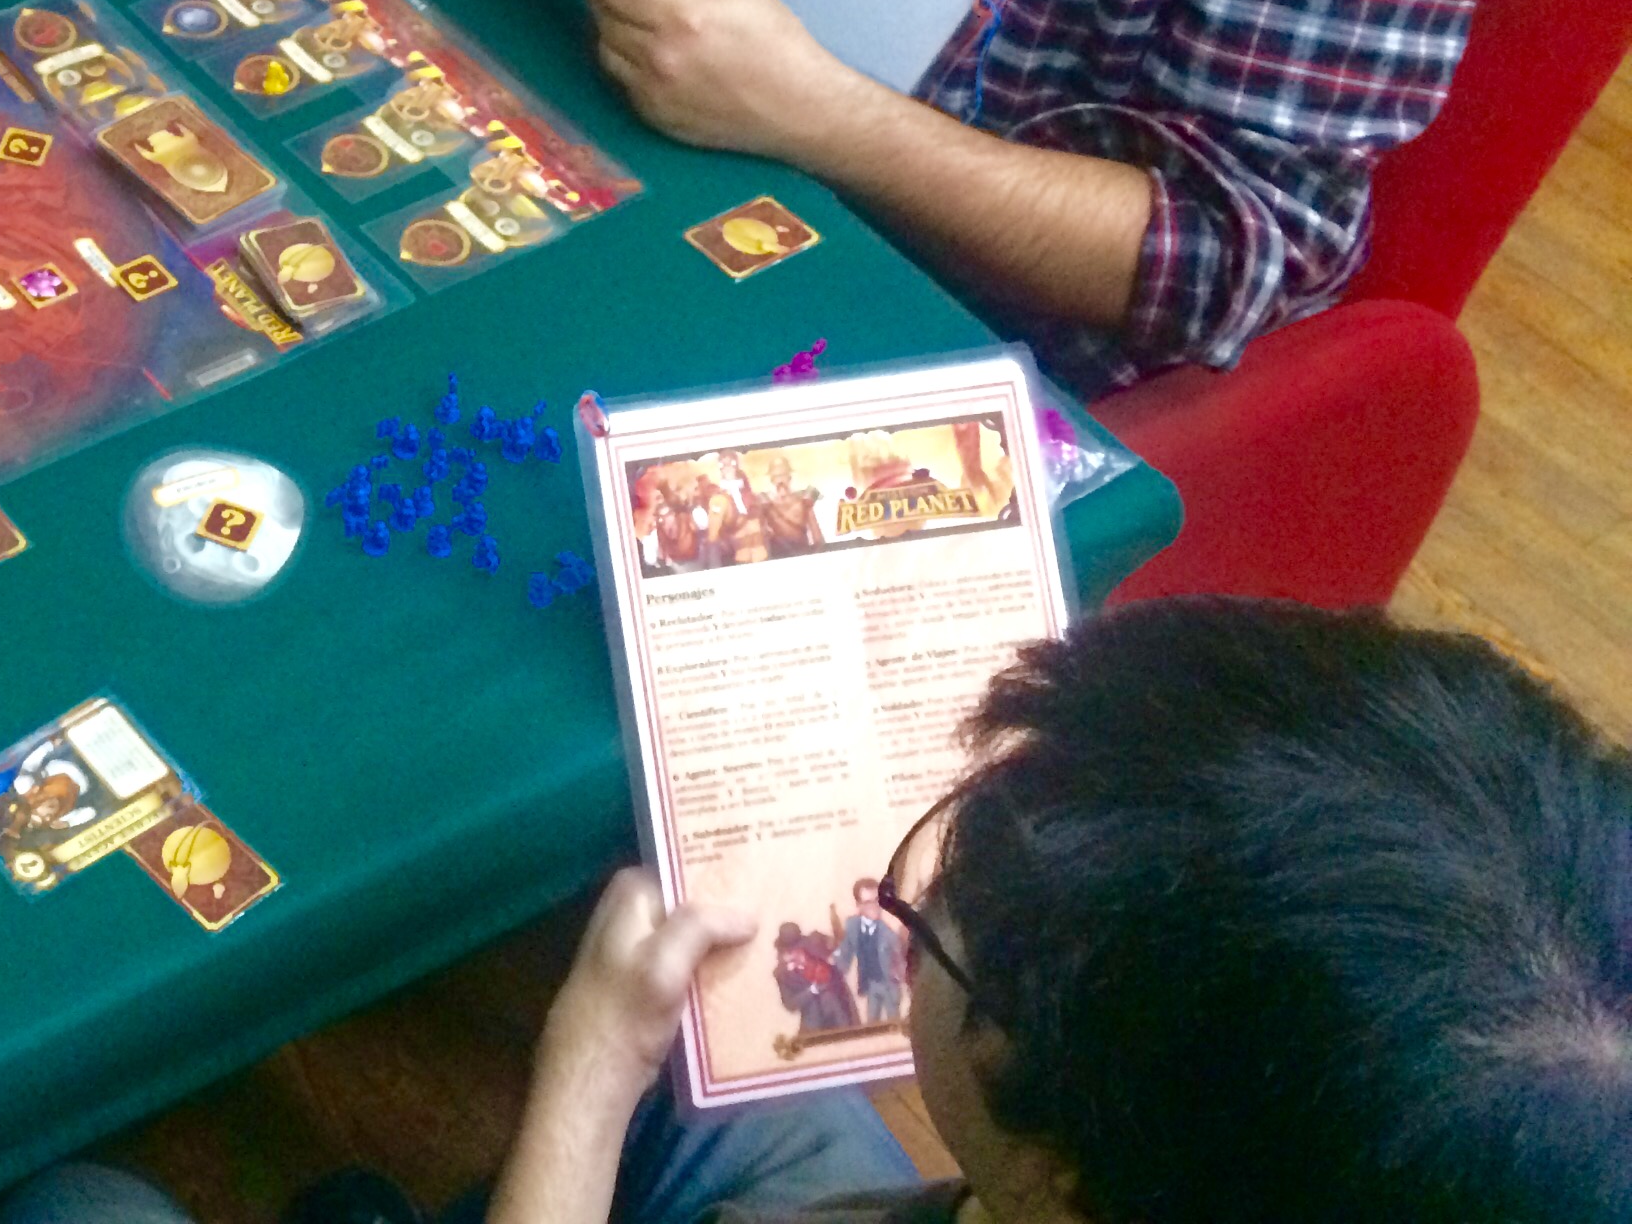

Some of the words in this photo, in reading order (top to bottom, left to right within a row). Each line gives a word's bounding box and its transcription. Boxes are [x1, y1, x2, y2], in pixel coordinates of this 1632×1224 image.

[840, 503, 884, 534] RED
[889, 492, 975, 520] PLANET
[76, 805, 142, 849] SCIENTIST
